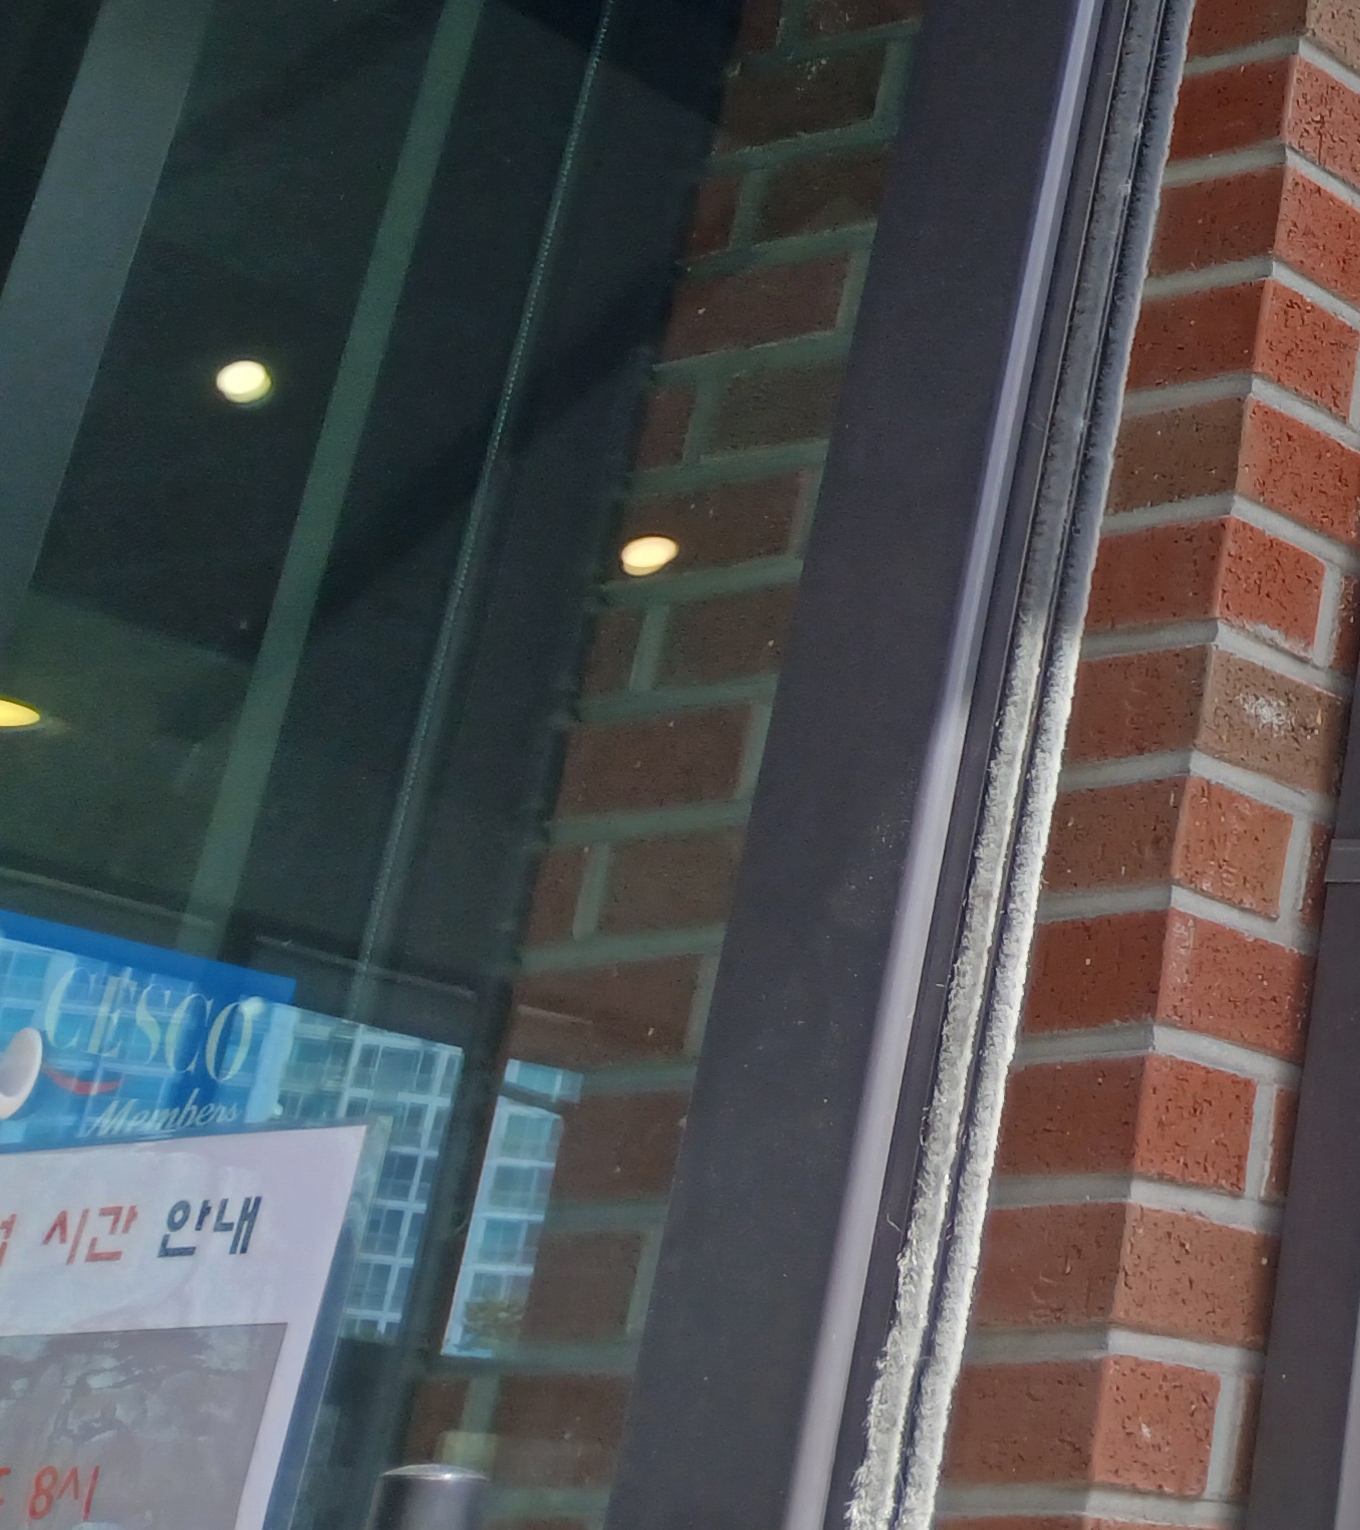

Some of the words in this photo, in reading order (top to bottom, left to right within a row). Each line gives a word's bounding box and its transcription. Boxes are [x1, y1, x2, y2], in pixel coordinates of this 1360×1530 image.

[44, 966, 253, 1082] CESCO
[84, 1087, 240, 1135] Members
[42, 1205, 138, 1265] 시간
[157, 1196, 262, 1258] 안내
[29, 1465, 100, 1521] 8시
